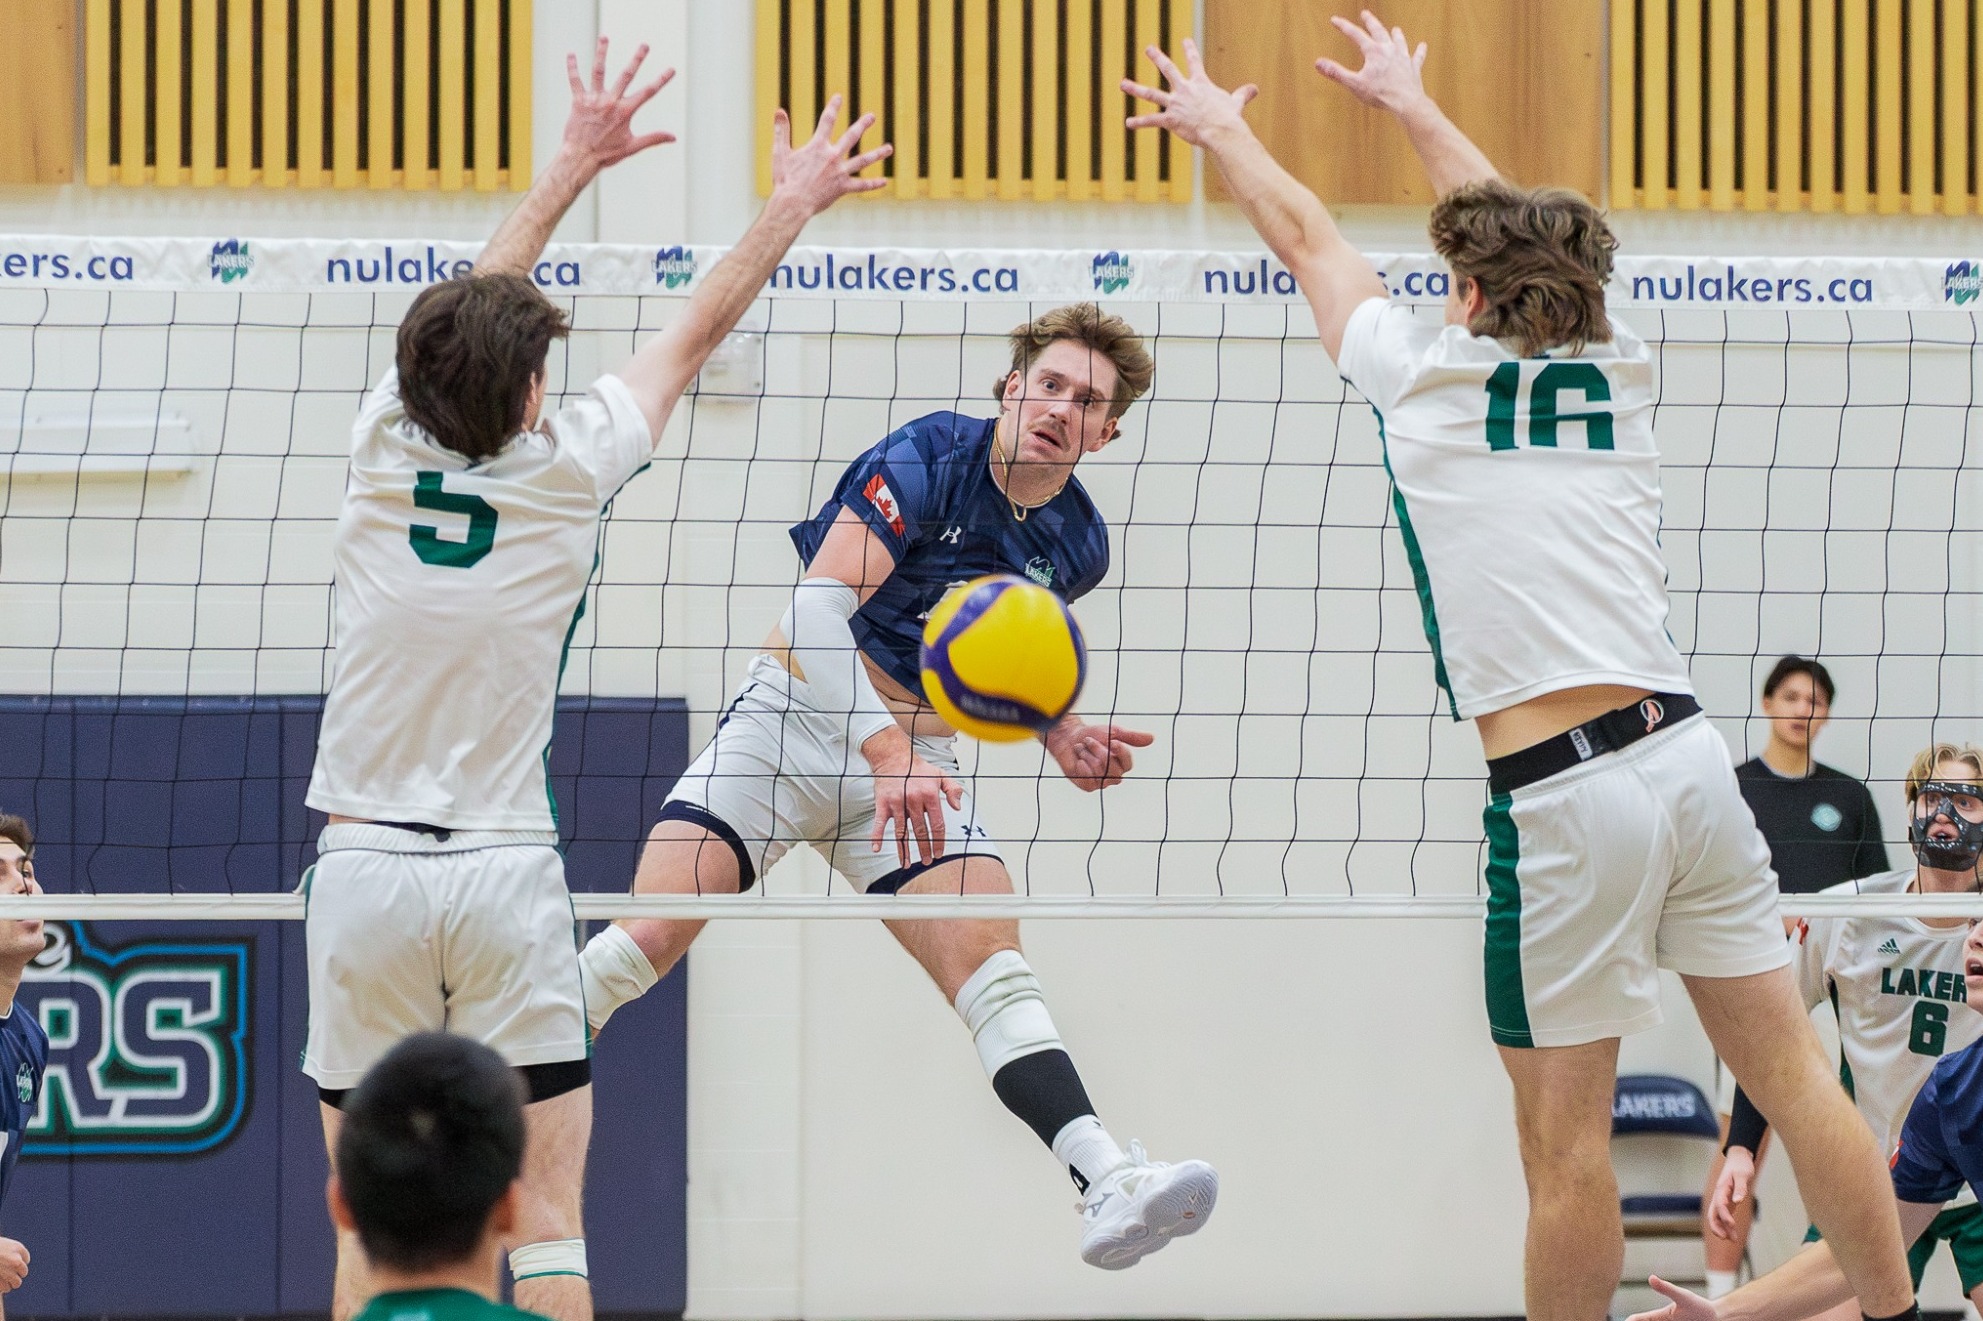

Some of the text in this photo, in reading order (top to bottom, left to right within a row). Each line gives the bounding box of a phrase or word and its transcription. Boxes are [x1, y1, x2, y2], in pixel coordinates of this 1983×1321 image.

[0, 253, 133, 280] ers.ca
[327, 246, 580, 286] nulakeca
[770, 253, 1019, 292] nulakers.ca
[1204, 259, 1449, 296] nula.ca
[1632, 265, 1873, 303] nulakers.ca
[1485, 361, 1615, 452] 16
[409, 470, 499, 569] 5
[1881, 967, 1967, 1004] LAKER
[1908, 1000, 1949, 1058] 6
